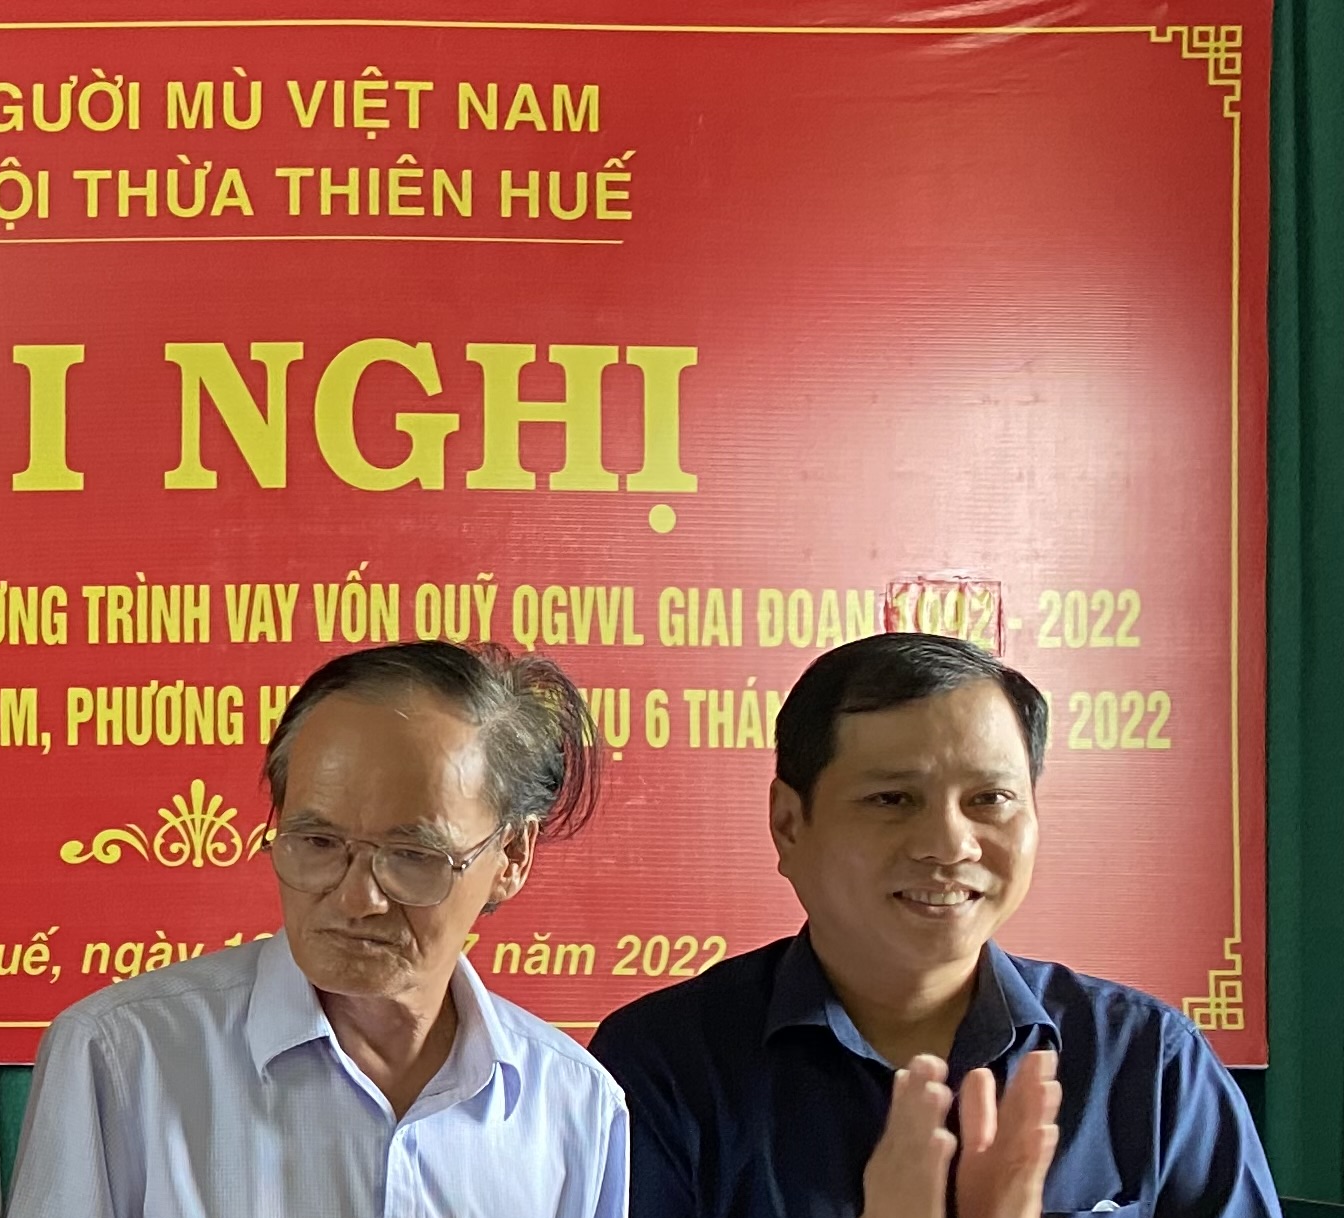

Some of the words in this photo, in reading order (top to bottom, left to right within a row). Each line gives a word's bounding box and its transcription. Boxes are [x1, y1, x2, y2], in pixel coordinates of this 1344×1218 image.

[166, 66, 263, 131] MÙ
[287, 65, 435, 141] VIỆT
[458, 81, 601, 133] NAM
[72, 153, 253, 219] THỪA
[275, 152, 473, 218] THIÊN
[500, 151, 634, 221] HUẾ
[162, 336, 699, 535] NGHỊ
[82, 571, 210, 645] TRÌNH
[224, 583, 301, 644] VAY
[312, 560, 400, 643] VỐN
[511, 584, 645, 652] QGVVL
[658, 586, 744, 647] GIAI
[1036, 588, 1142, 648] 2022
[66, 679, 245, 746] PHƯƠNG
[644, 688, 672, 749] 6
[1067, 689, 1172, 750] 2022
[491, 931, 597, 976] năm
[611, 934, 728, 978] 2022
